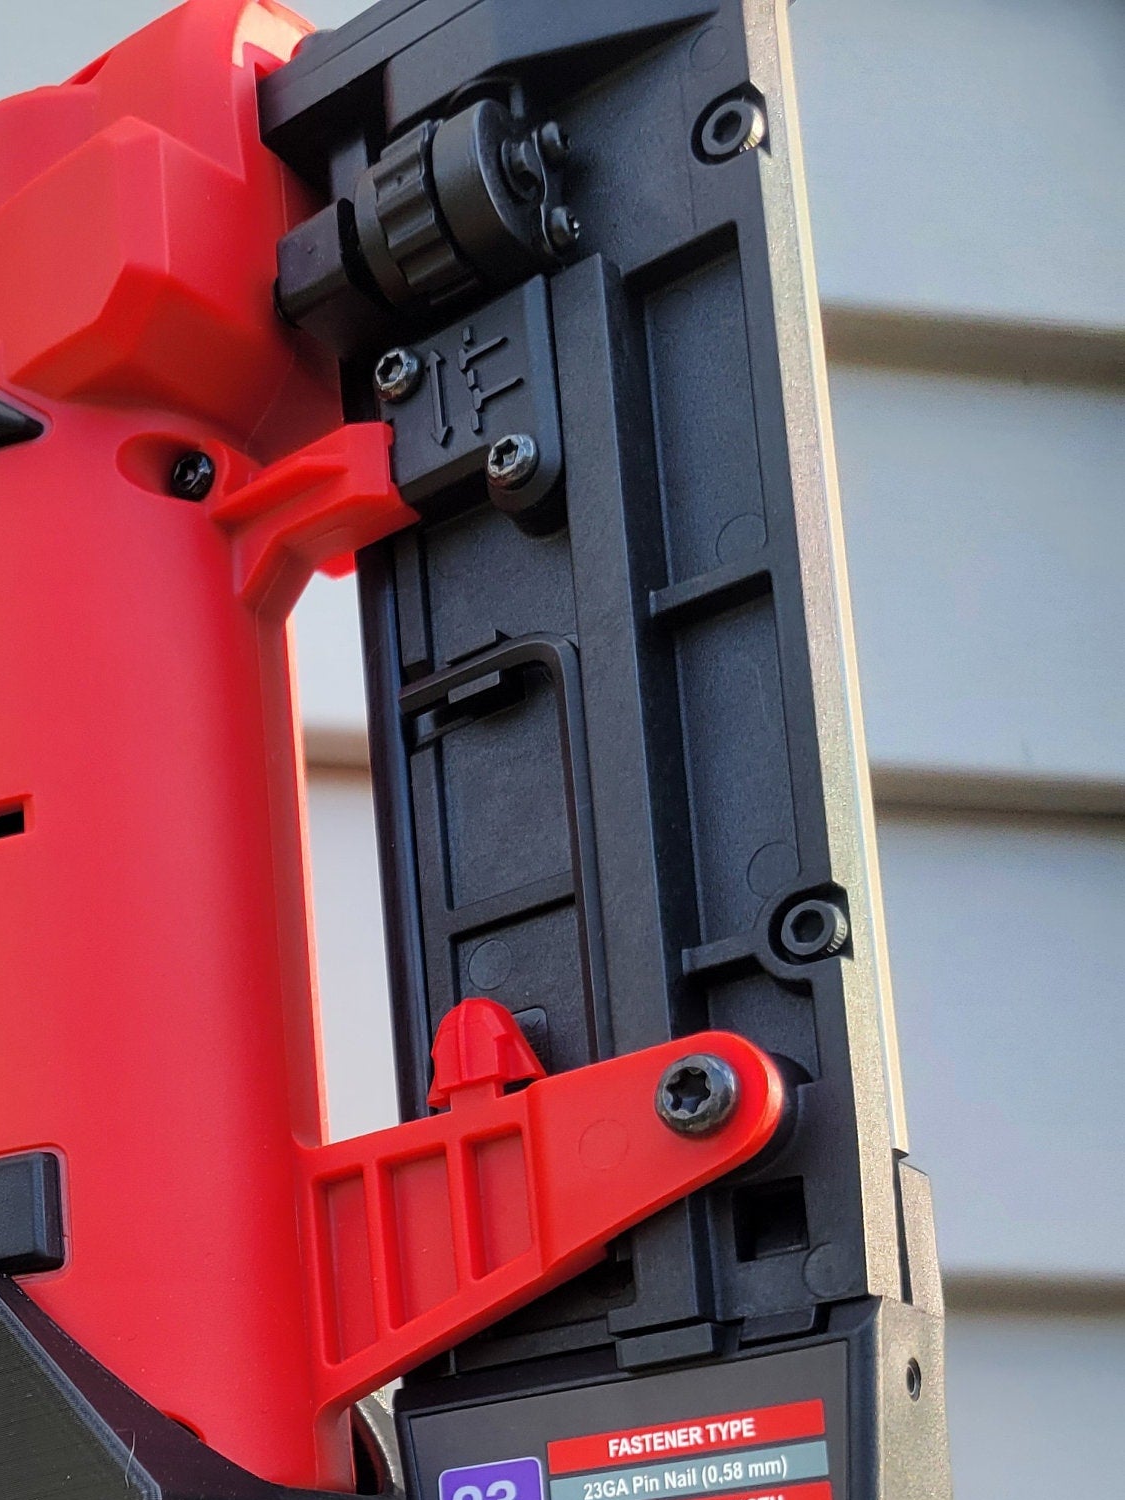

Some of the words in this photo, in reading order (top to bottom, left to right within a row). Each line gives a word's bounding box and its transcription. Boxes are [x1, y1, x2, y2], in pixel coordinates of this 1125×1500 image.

[608, 1427, 704, 1459] FASTENER
[706, 1417, 756, 1444] TYPE
[633, 1474, 660, 1497] Pin
[664, 1470, 697, 1491] Nail
[701, 1461, 744, 1490] (0,58
[747, 1454, 788, 1478] mm)
